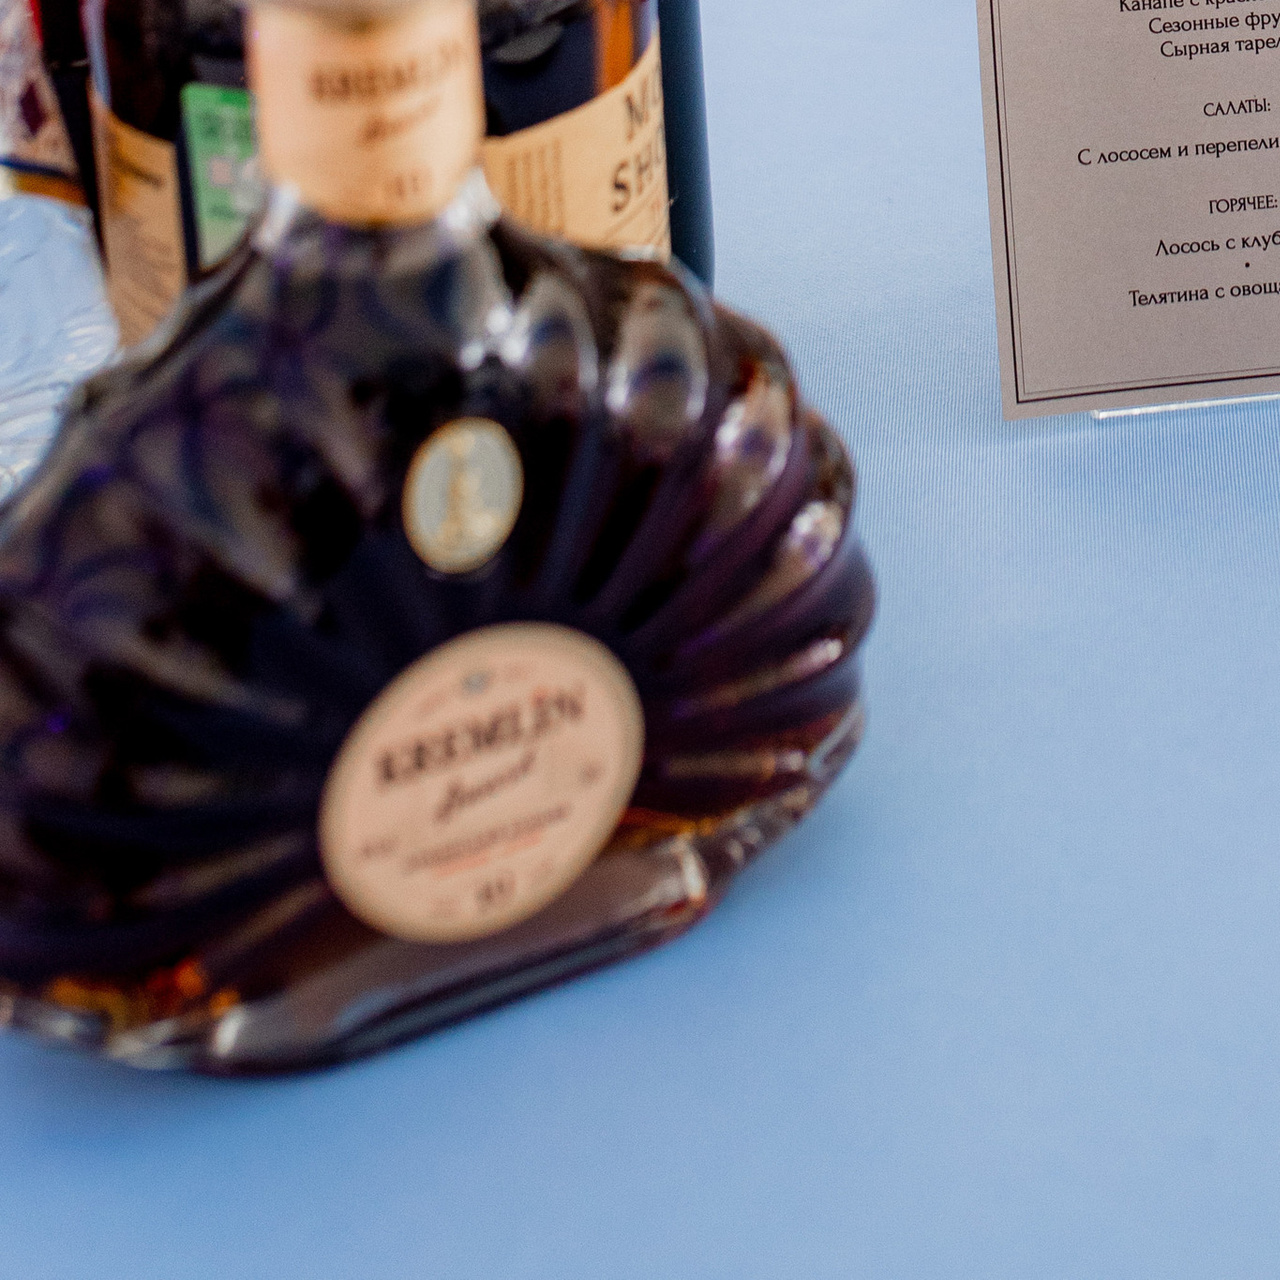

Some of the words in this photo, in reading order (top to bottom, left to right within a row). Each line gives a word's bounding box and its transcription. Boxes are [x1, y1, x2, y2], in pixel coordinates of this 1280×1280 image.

[1148, 16, 1240, 35] Сезонные
[1160, 40, 1230, 61] Сырная
[1202, 99, 1272, 118] САЛАТЫ:
[1077, 148, 1092, 166] С
[1096, 146, 1172, 165] лососем
[1177, 144, 1189, 157] и
[1208, 194, 1279, 215] ГОРЯЧЕЕ:
[1155, 239, 1221, 257] Лосось
[1225, 237, 1236, 250] с
[1128, 288, 1210, 308] Телятина
[1214, 286, 1226, 299] с
